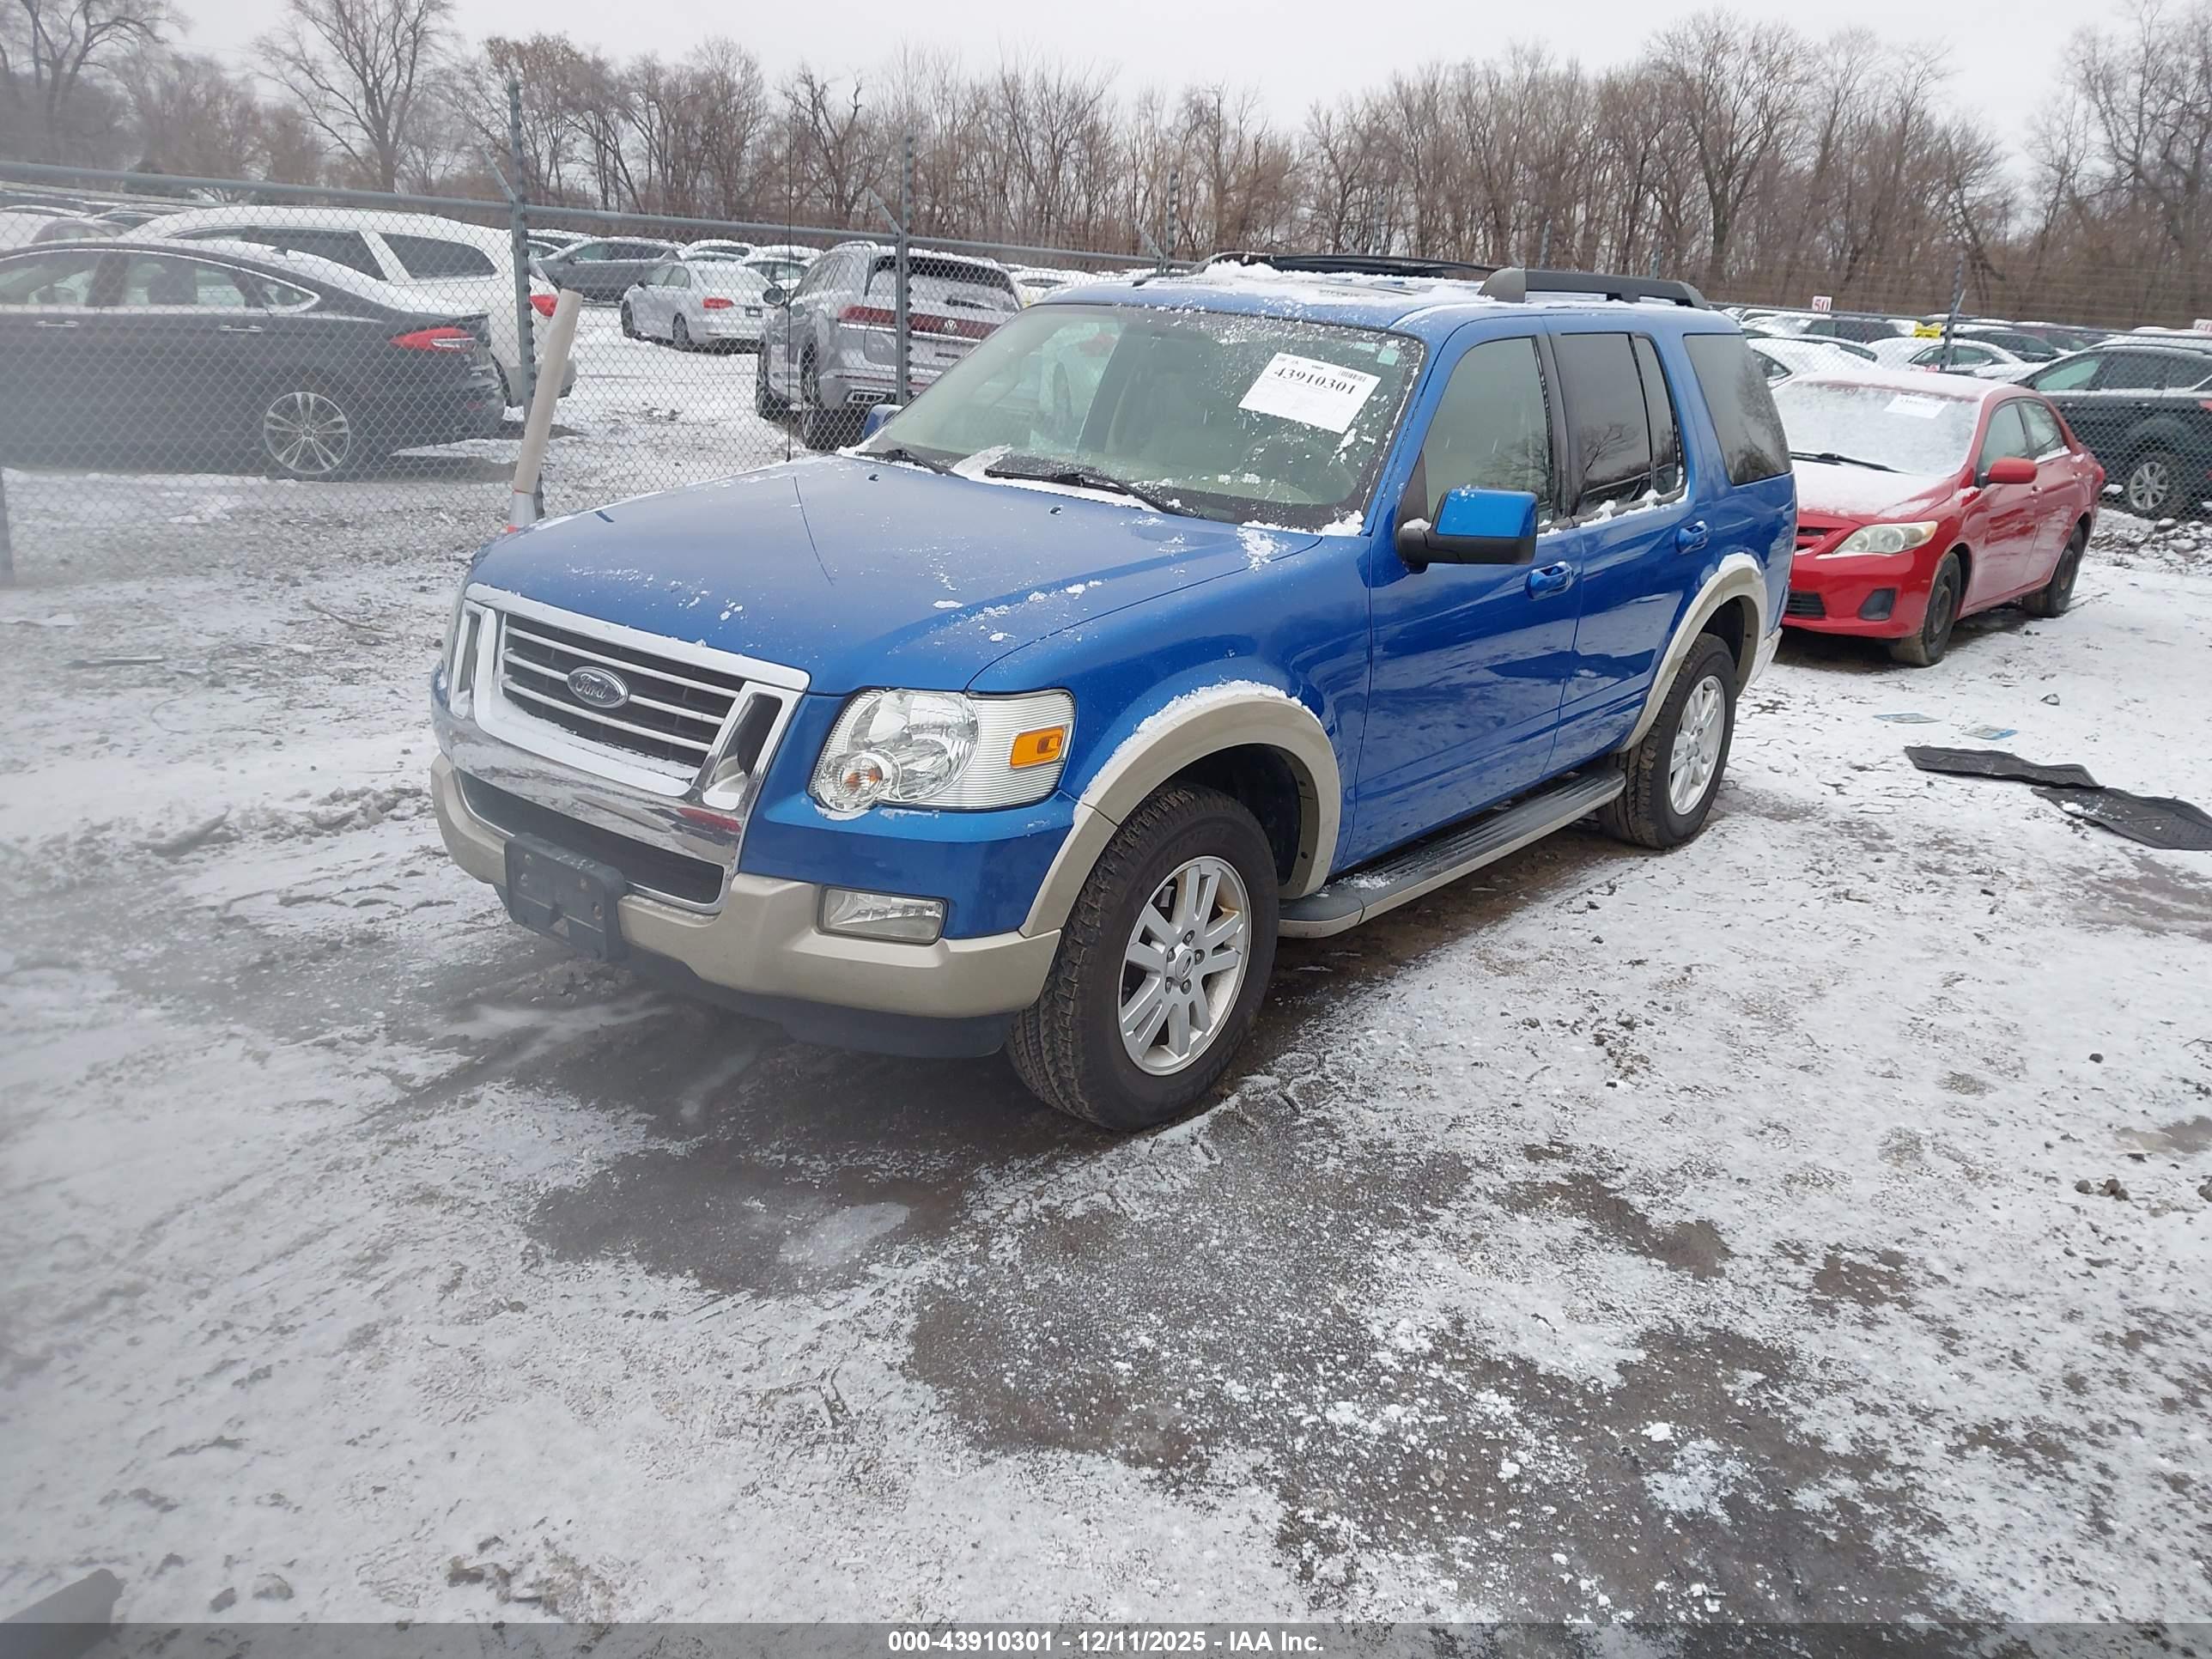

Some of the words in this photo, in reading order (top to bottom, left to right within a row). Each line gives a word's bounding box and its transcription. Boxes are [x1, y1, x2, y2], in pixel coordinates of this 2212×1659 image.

[1814, 298, 1829, 312] 50
[1273, 367, 1357, 395] 43910301
[575, 672, 608, 700] Ford
